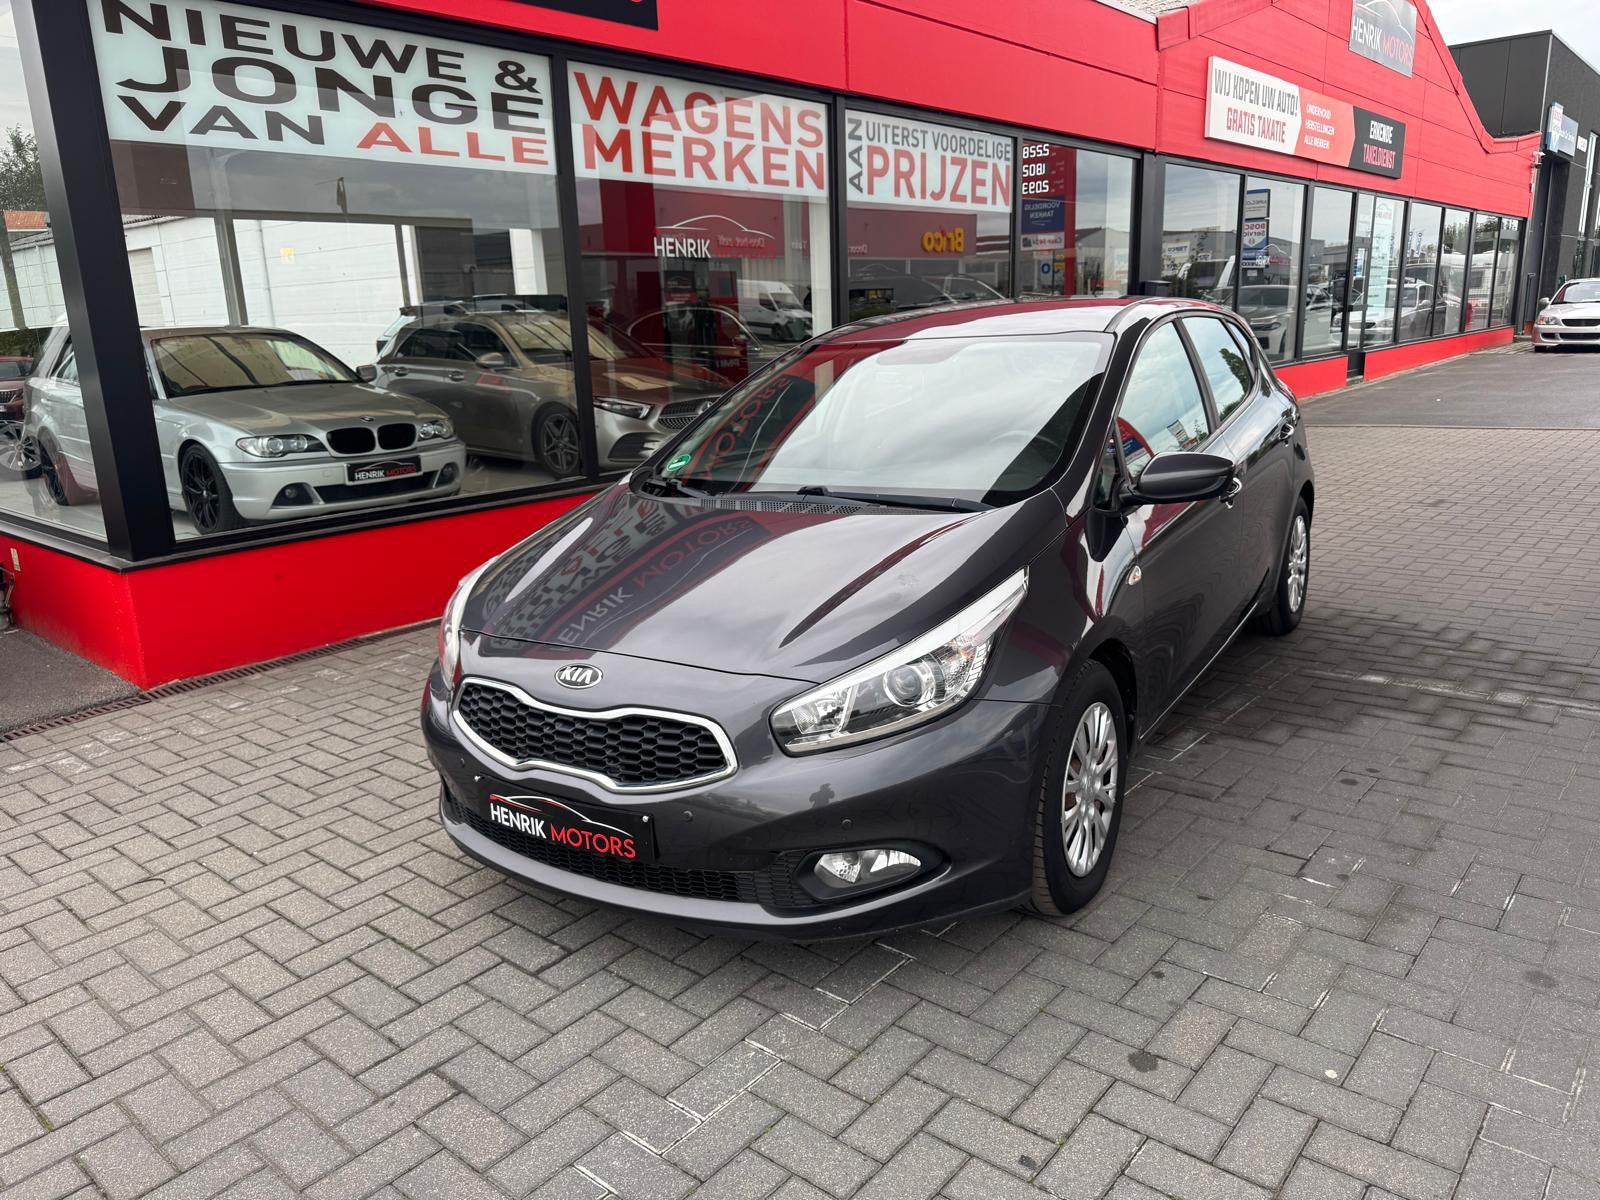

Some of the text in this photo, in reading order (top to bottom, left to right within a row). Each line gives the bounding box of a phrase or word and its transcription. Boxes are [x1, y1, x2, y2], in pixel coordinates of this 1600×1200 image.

[102, 0, 541, 94] NIEUWE &
[1351, 15, 1382, 52] HENRIK
[115, 46, 546, 135] JONGE
[574, 71, 824, 148] WAGENS
[1214, 68, 1299, 117] WIJ KOPEN UW AUTO!
[116, 95, 549, 166] VAN ALLE
[866, 121, 1011, 162] UITERST VOORDELIGE
[1226, 107, 1286, 143] GRATIS TAXATIE
[582, 124, 825, 190] MERKEN
[847, 118, 864, 194] AAN
[866, 144, 1011, 207] PRIJZEN
[653, 236, 711, 258] HENRIK
[354, 470, 385, 481] HENRIK
[560, 666, 592, 684] KIA
[490, 802, 636, 858] HENRIK MOTORS
